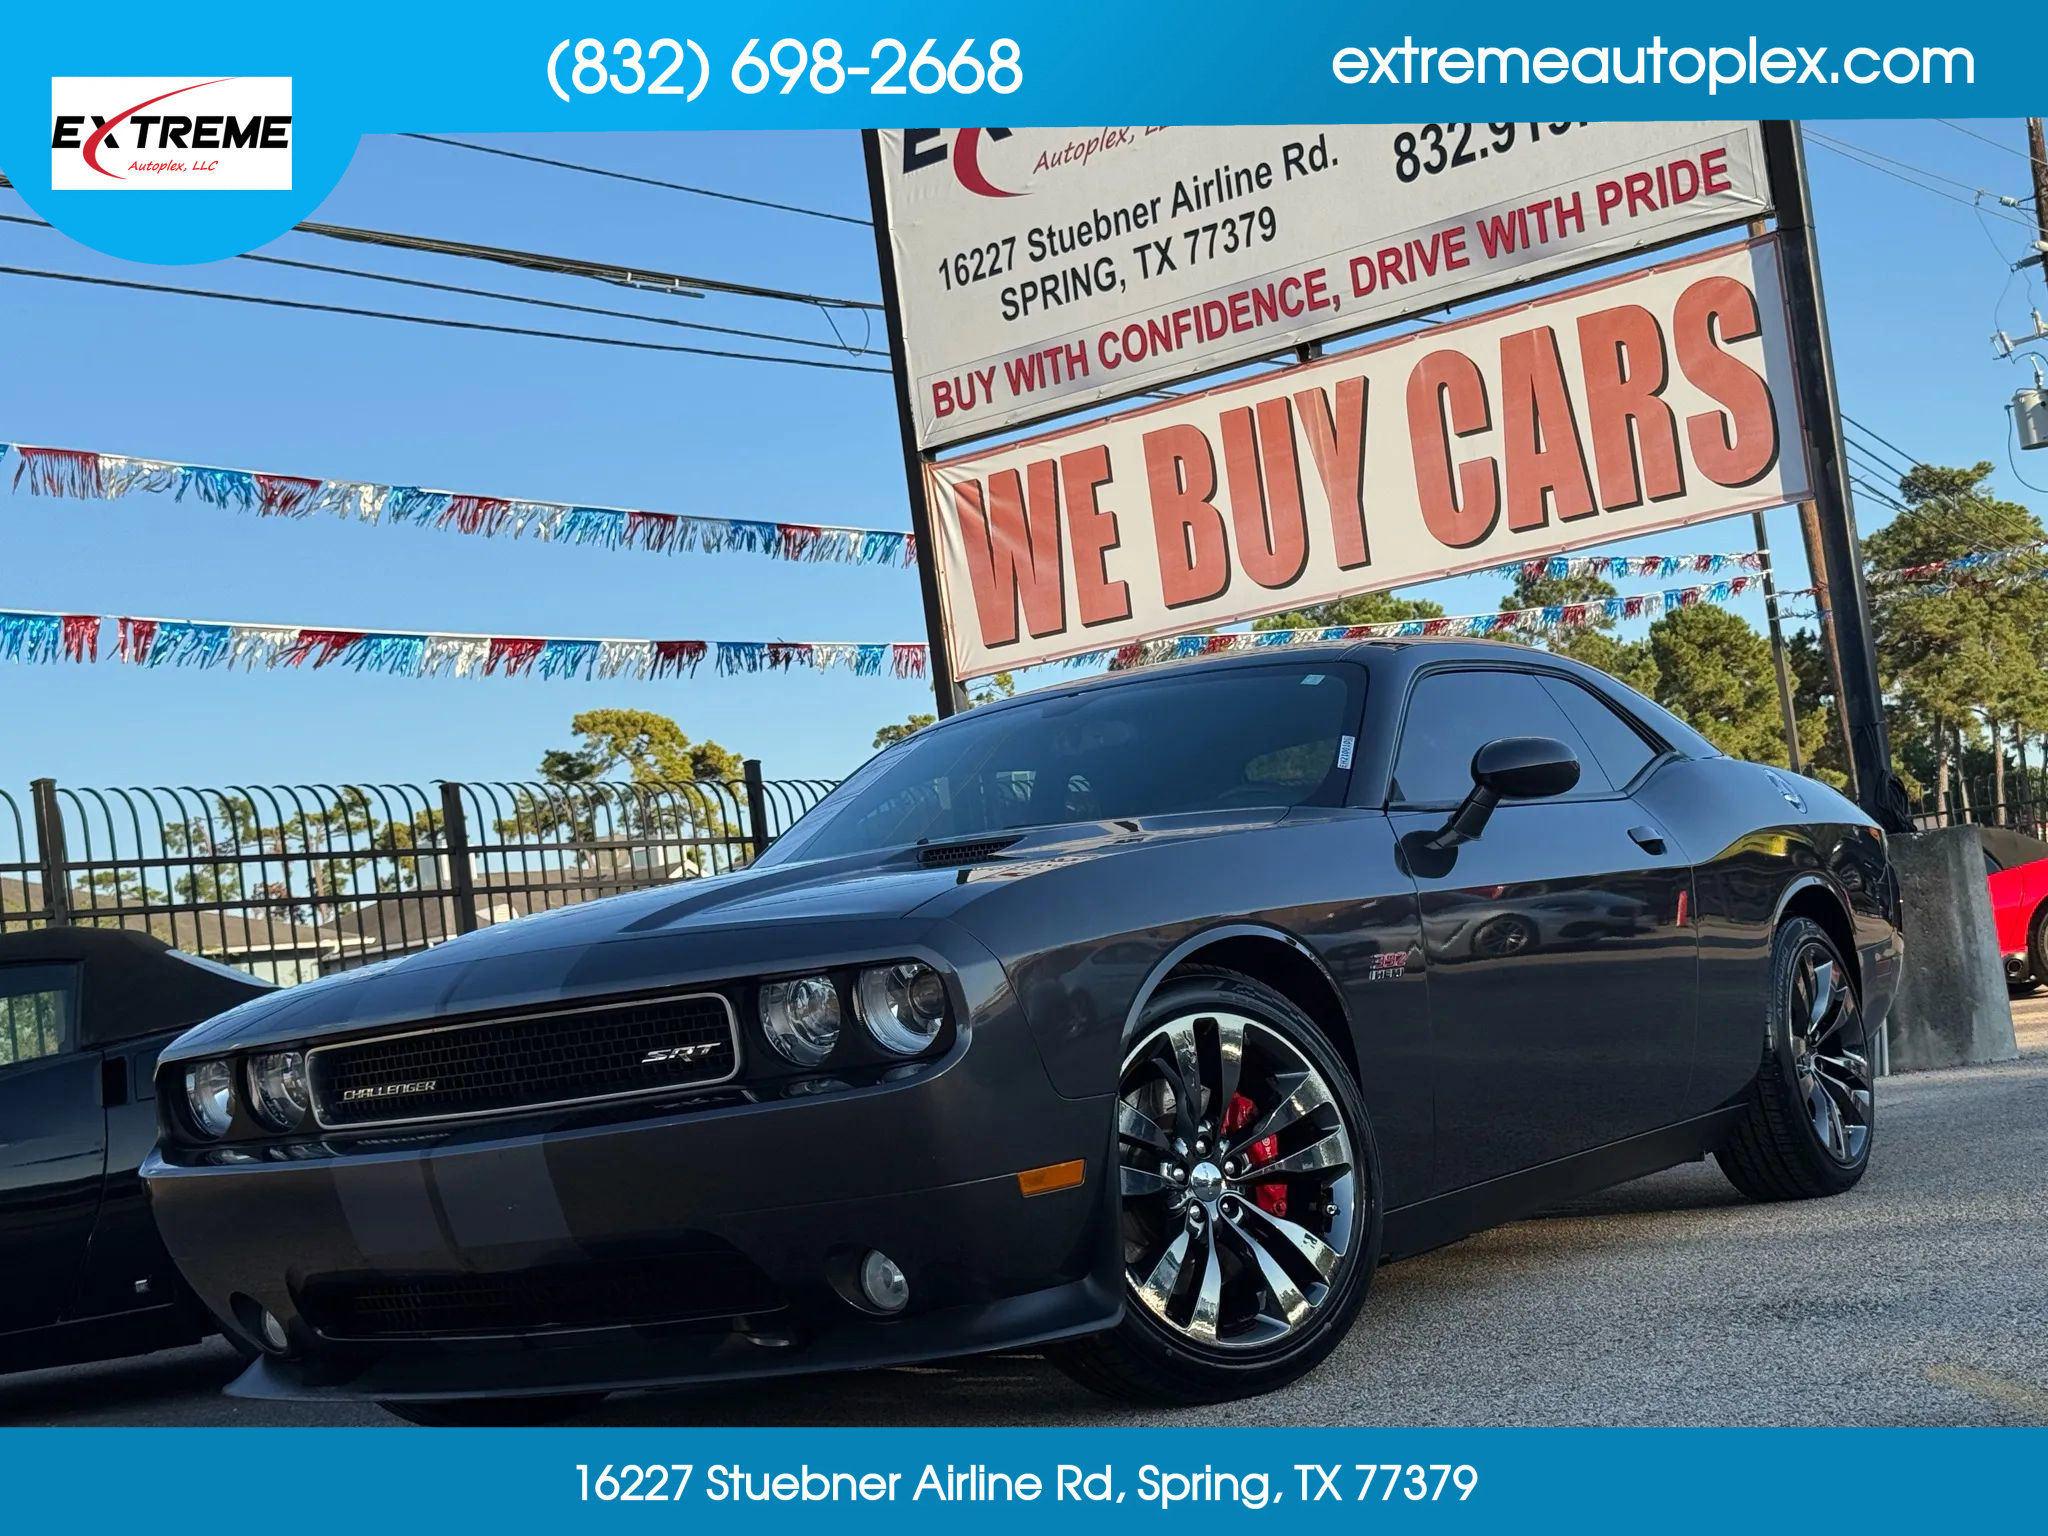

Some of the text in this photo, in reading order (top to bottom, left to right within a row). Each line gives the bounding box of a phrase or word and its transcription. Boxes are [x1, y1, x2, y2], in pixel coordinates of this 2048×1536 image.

[938, 133, 1339, 292] 16227 Stuebner Airline Rd.
[1000, 205, 1278, 322] SPRING, TX 77379
[932, 147, 1732, 418] BUY WITH CONFIDENCE, DRIVE WITH PRIDE
[953, 275, 1782, 648] WE BUY CARS
[343, 1079, 437, 1101] CHALLENGER
[641, 1042, 722, 1064] SRT
